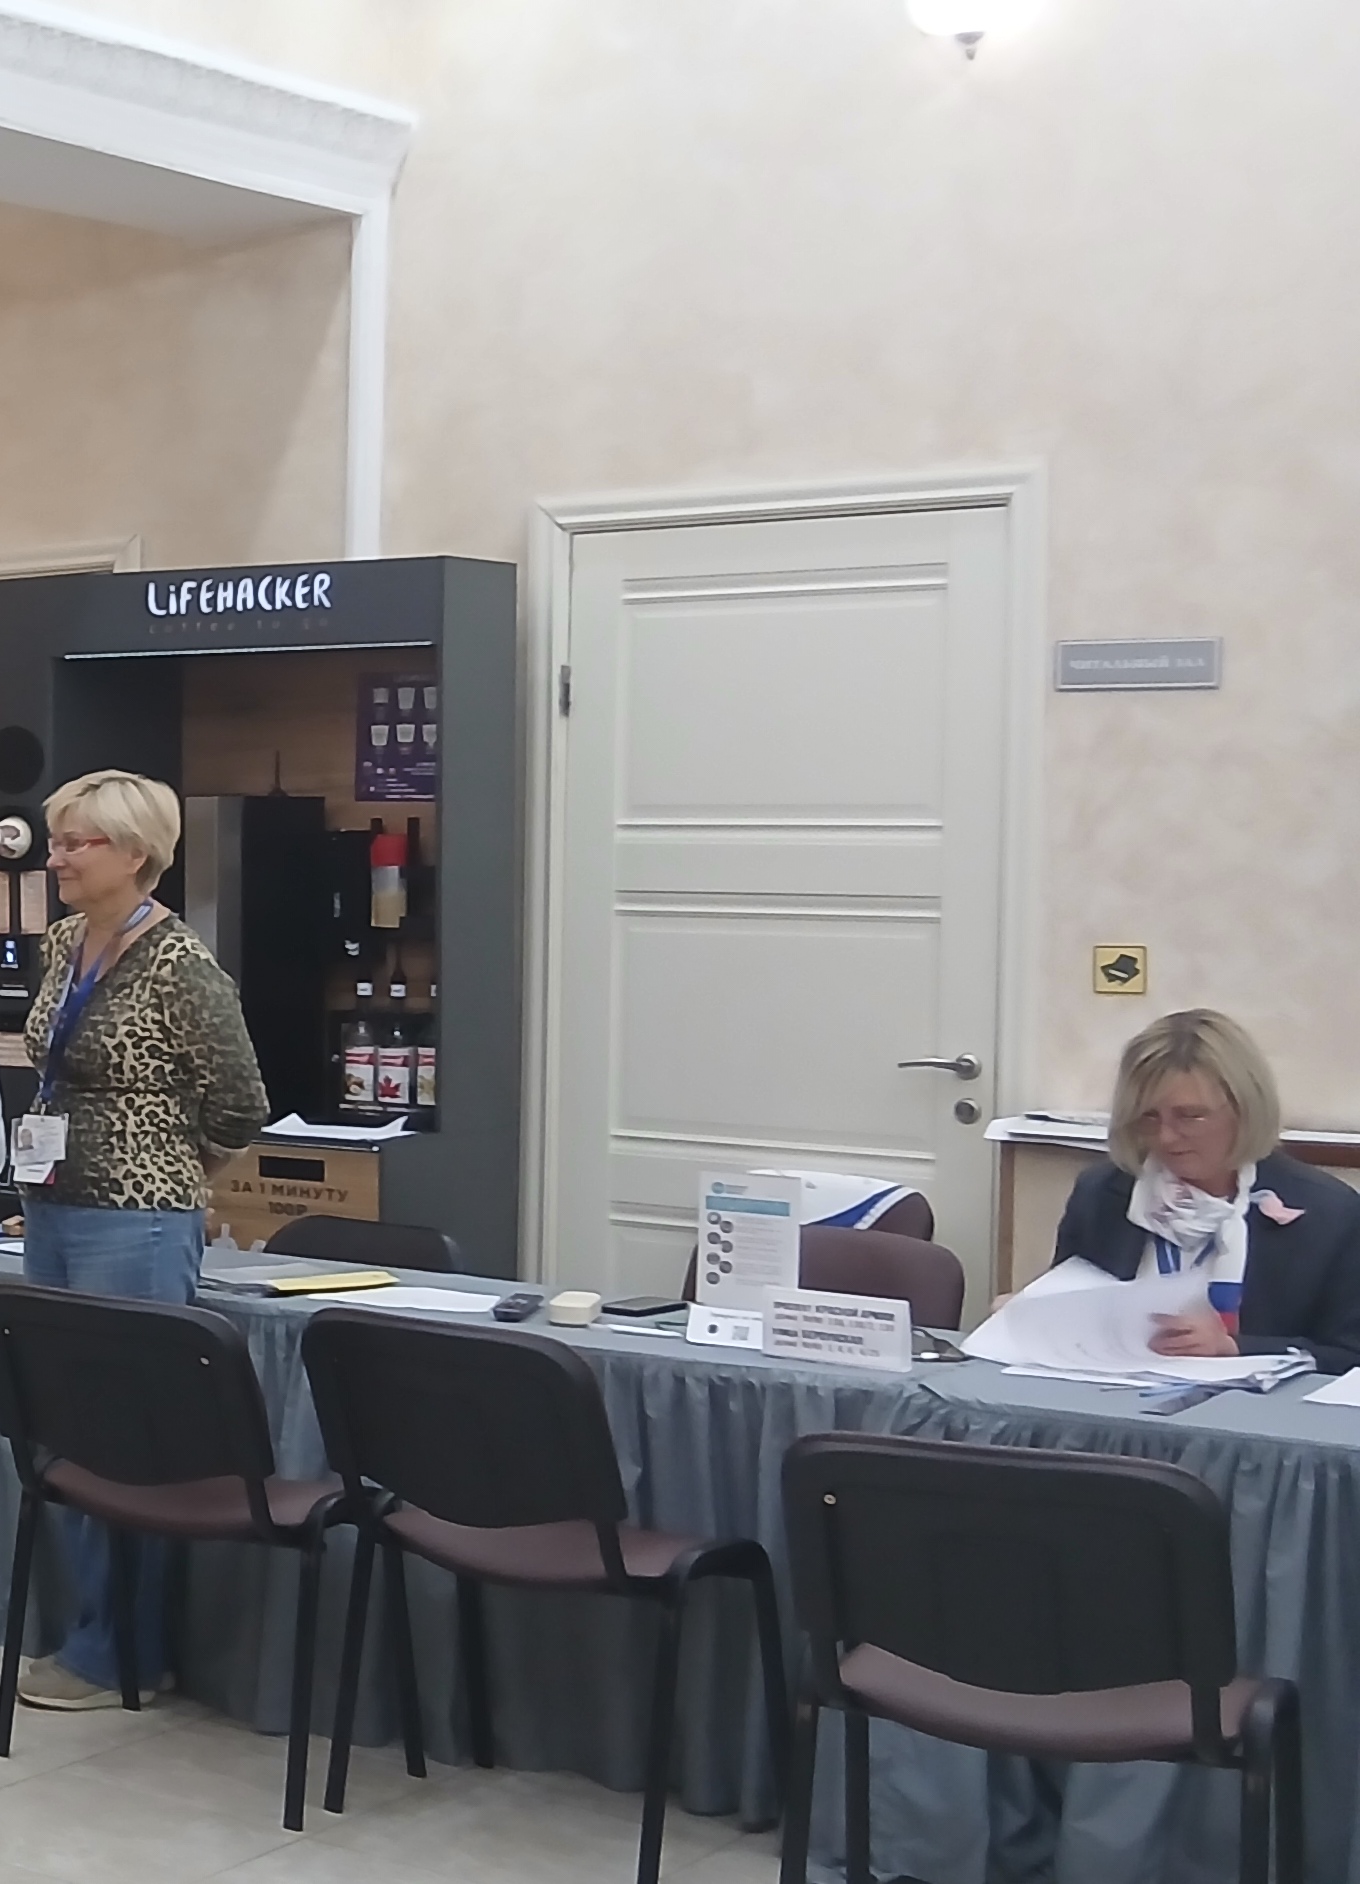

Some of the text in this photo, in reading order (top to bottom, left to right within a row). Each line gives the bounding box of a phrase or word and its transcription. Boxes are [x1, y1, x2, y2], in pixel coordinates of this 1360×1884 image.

[230, 1179, 348, 1203] ЗА 1 МИНУТУ
